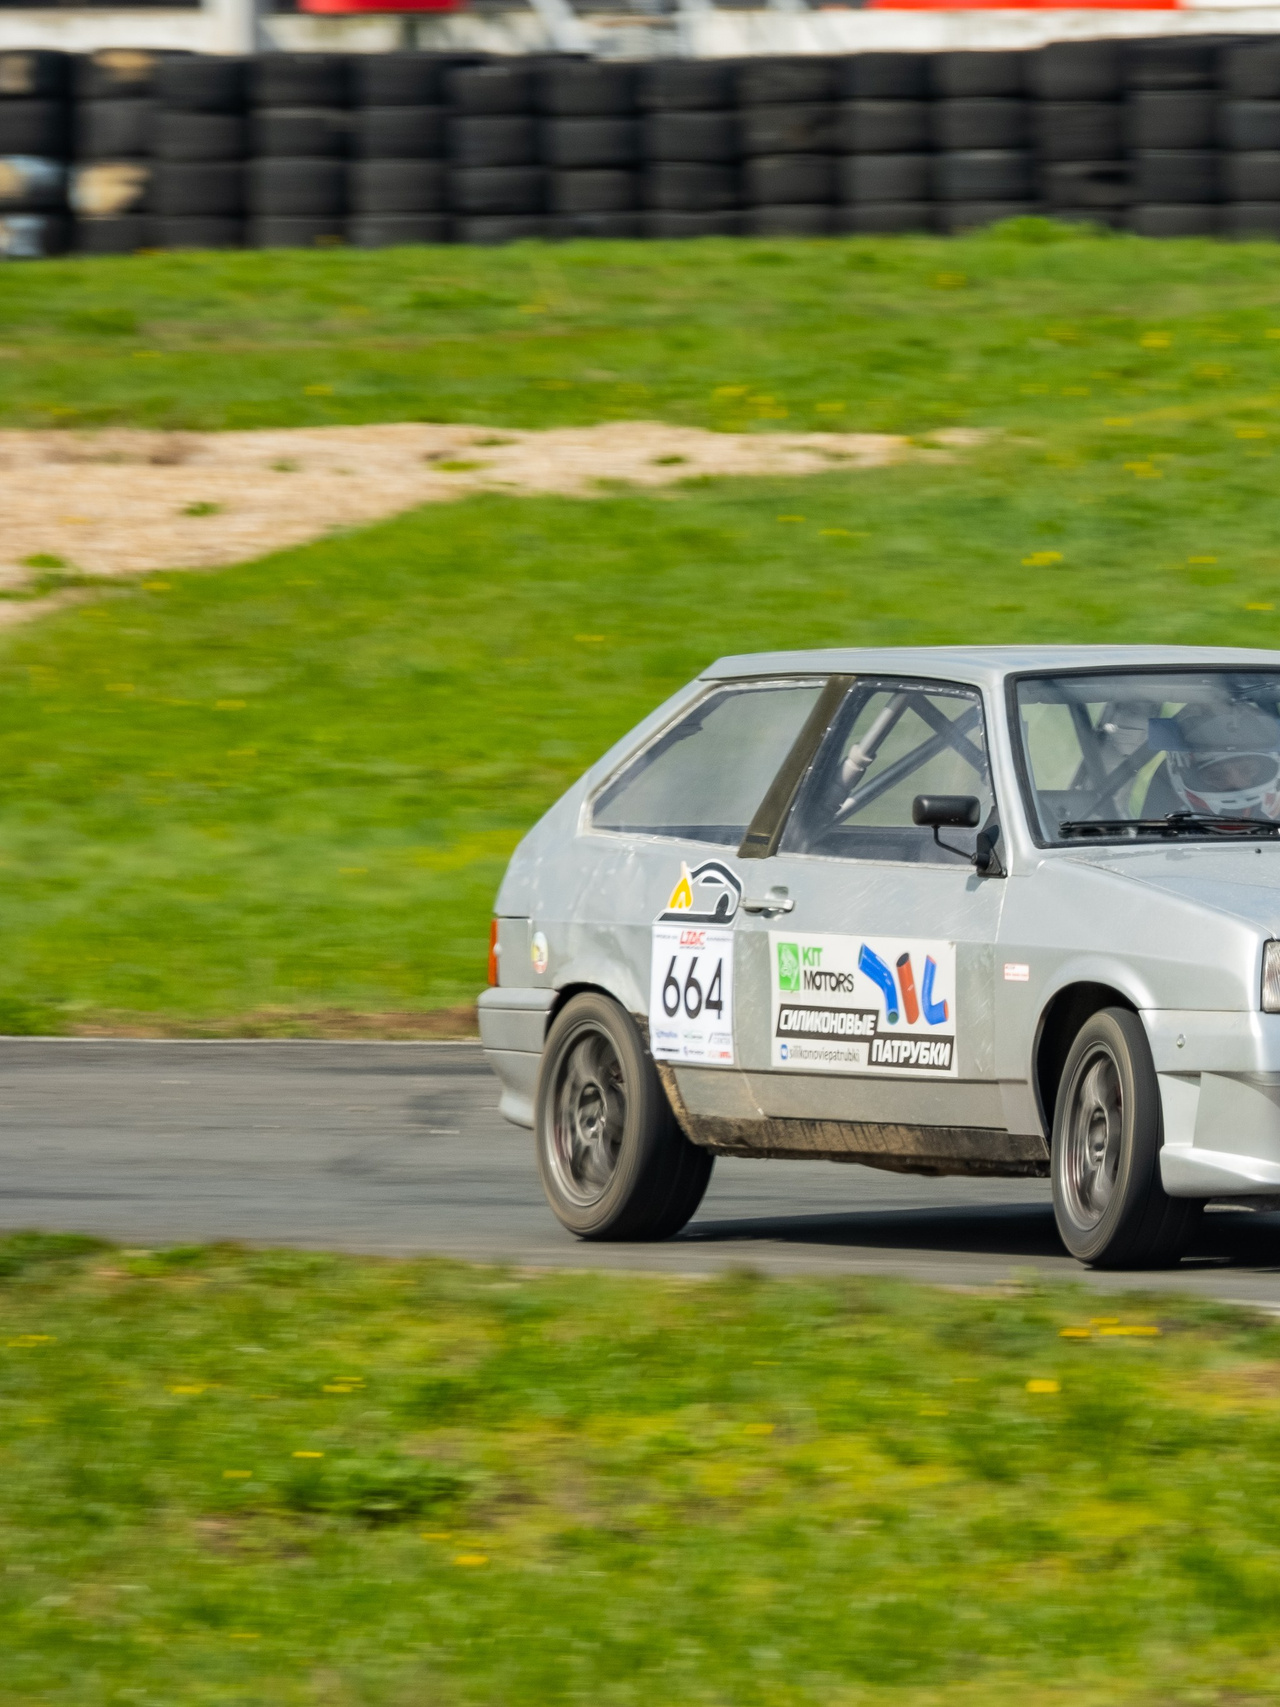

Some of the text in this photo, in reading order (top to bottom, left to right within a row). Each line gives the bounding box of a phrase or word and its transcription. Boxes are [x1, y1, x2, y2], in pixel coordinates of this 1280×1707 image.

[802, 947, 823, 966] KIT
[662, 955, 723, 1020] 664
[804, 970, 854, 993] MOTORS
[779, 1009, 877, 1036] СИЛИКОНОВЫЕ
[871, 1039, 951, 1067] ПАТРУБКИ
